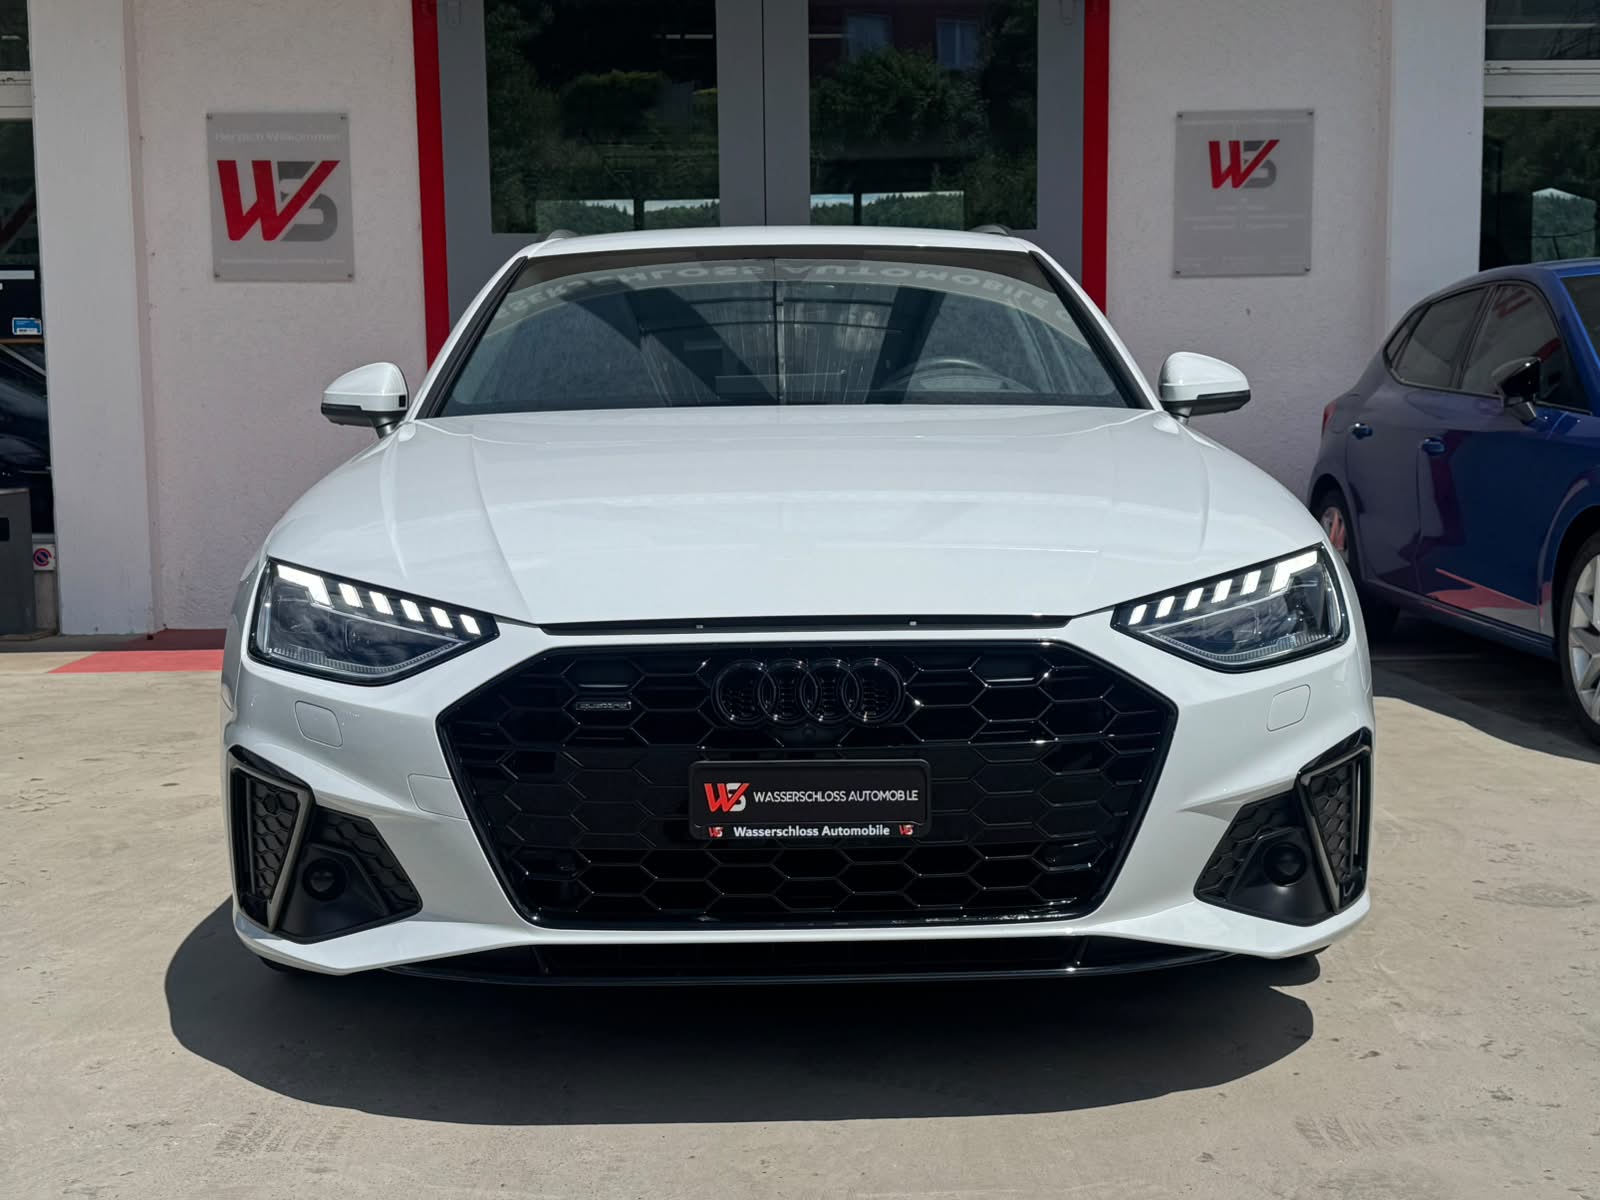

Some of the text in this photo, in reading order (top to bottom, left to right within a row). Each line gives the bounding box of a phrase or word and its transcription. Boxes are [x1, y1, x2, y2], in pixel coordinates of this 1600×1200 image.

[753, 791, 847, 803] WASSERSCHLOSS
[733, 825, 819, 838] Wasserschloss
[821, 824, 890, 837] Automobile
